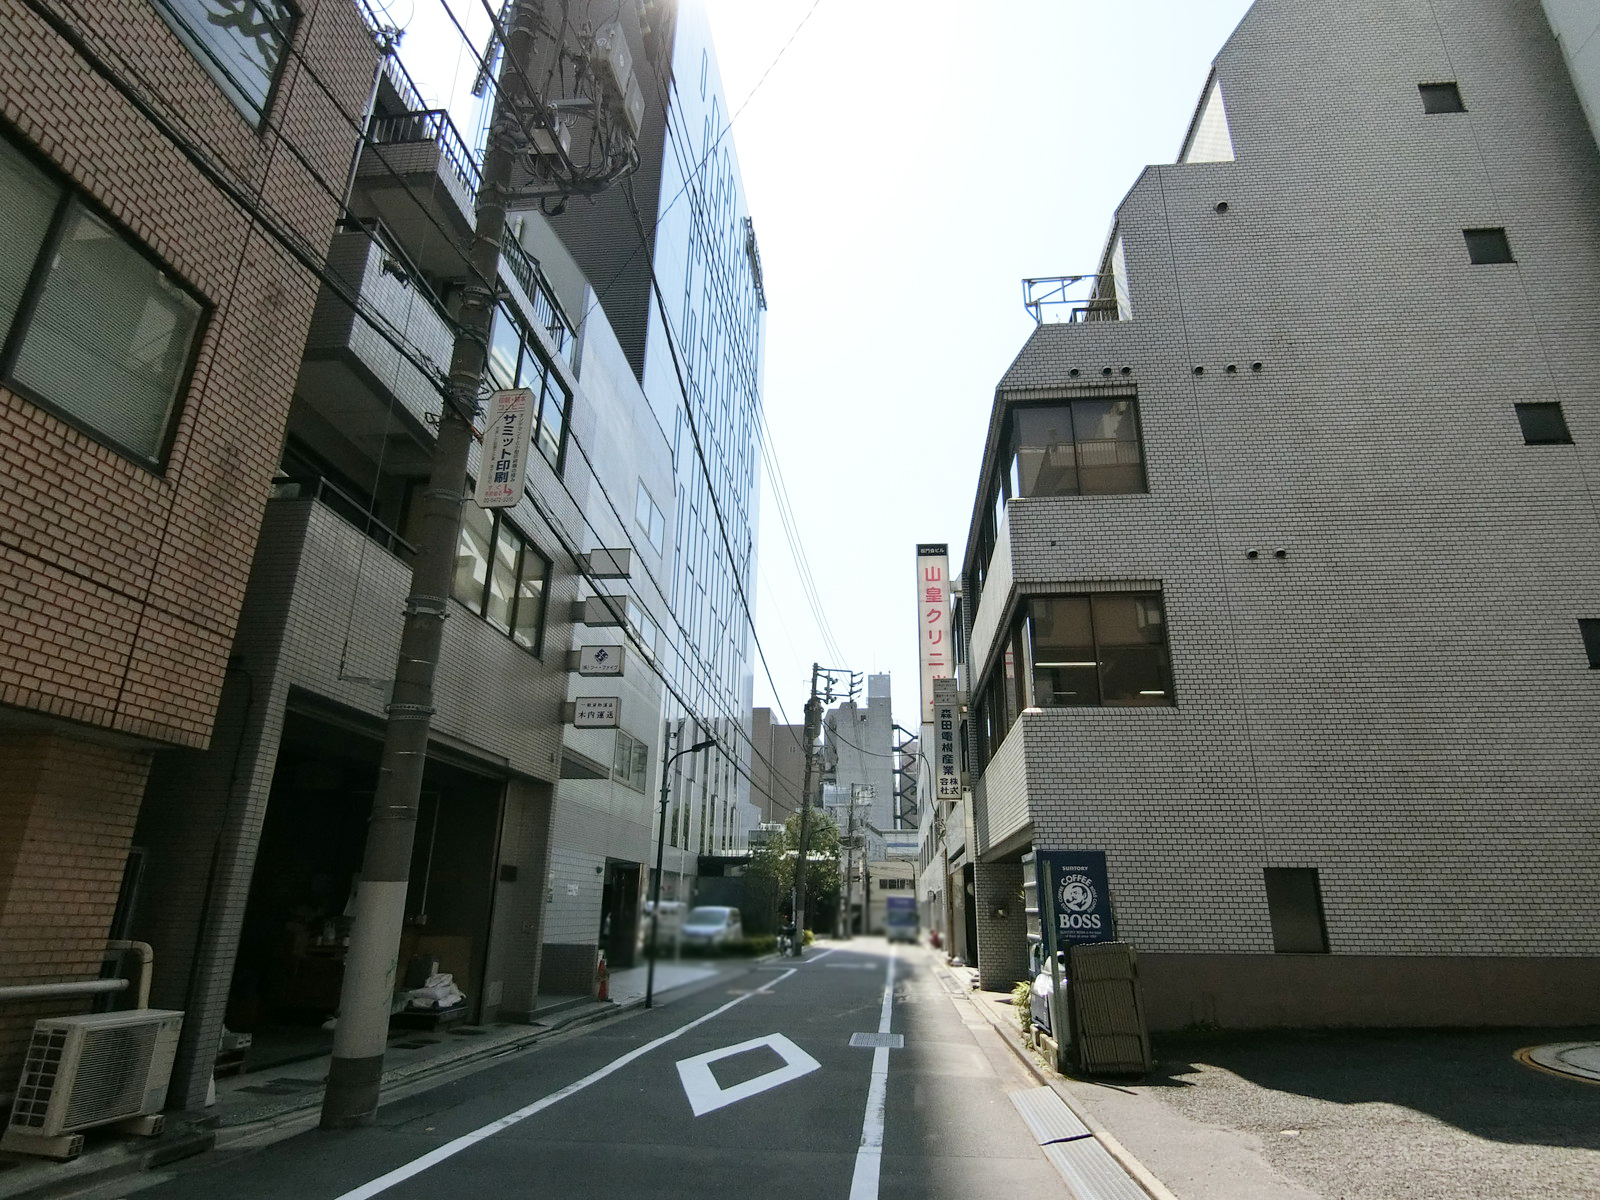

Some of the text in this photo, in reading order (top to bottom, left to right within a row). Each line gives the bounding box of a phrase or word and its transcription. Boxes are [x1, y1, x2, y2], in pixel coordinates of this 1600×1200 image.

[494, 414, 517, 483] サミット印刷
[924, 566, 947, 712] 山皇クリニ
[1060, 874, 1093, 887] COFFEE
[1059, 914, 1101, 929] BOSS
